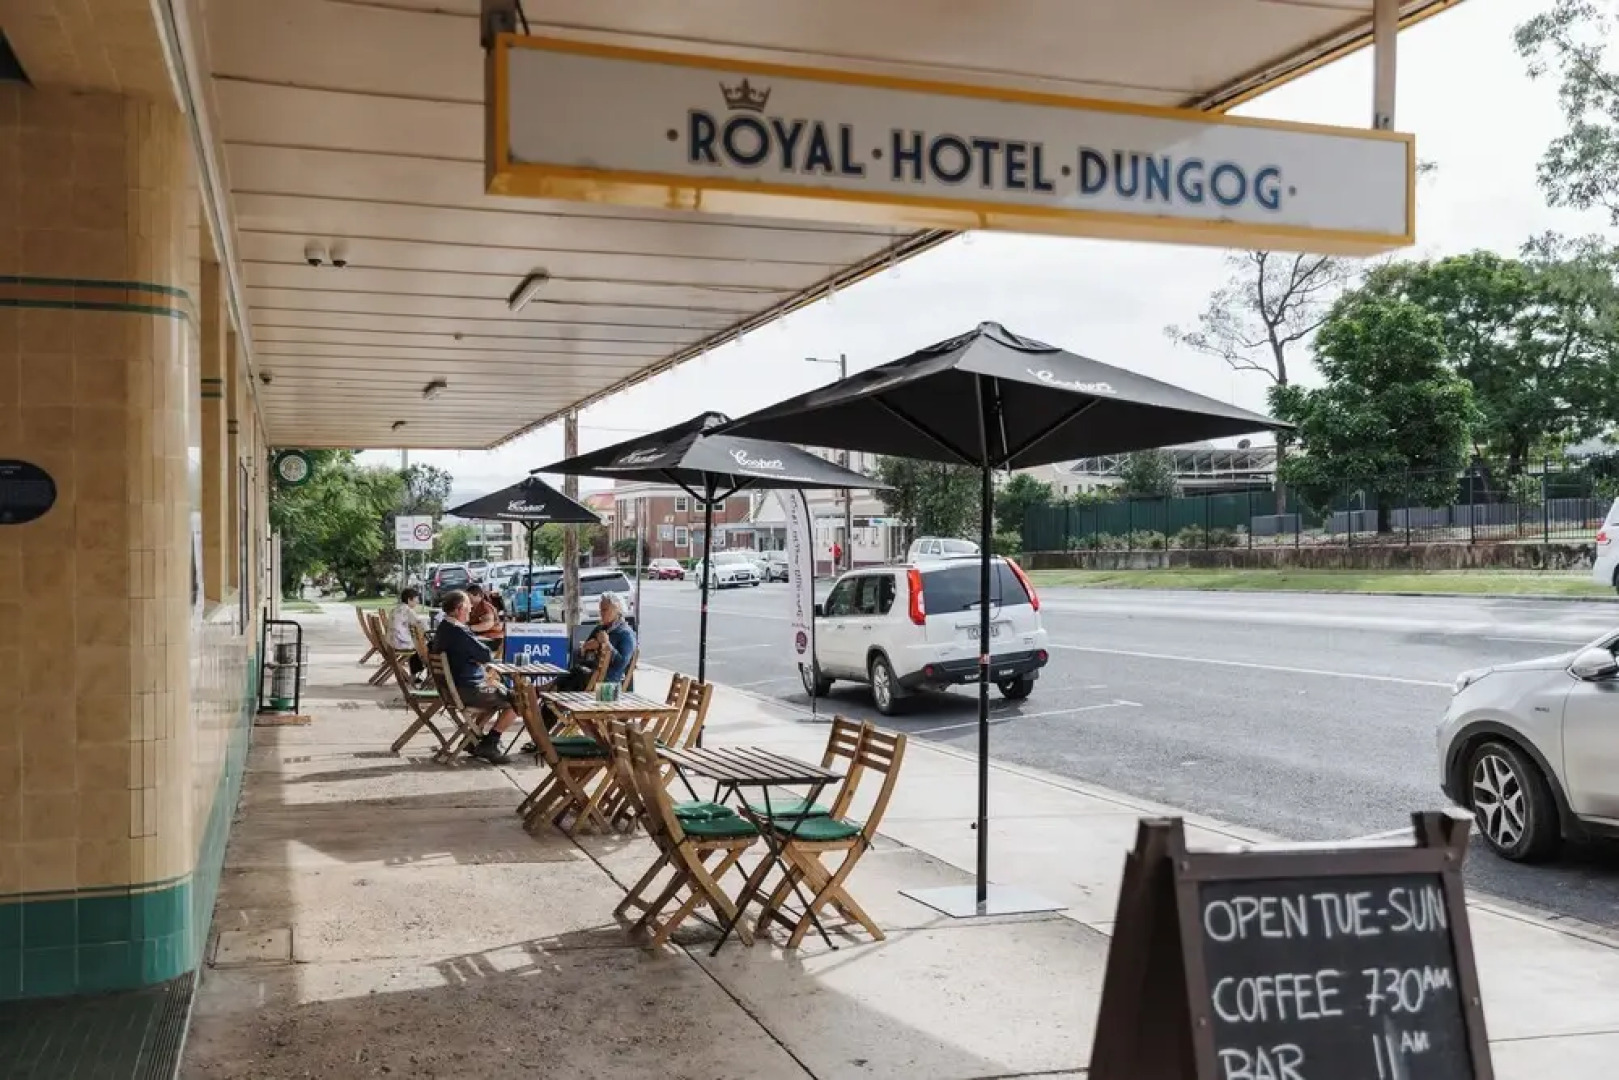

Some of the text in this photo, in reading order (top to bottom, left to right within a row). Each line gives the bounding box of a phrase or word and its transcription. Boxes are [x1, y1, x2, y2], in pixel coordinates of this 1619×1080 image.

[688, 109, 1282, 211] ROYAL HOTEL DUNGOG
[523, 643, 551, 657] BAR
[1204, 894, 1309, 942] OPEN
[1211, 968, 1345, 1023] COFFEE
[1217, 1043, 1305, 1080] BAR
